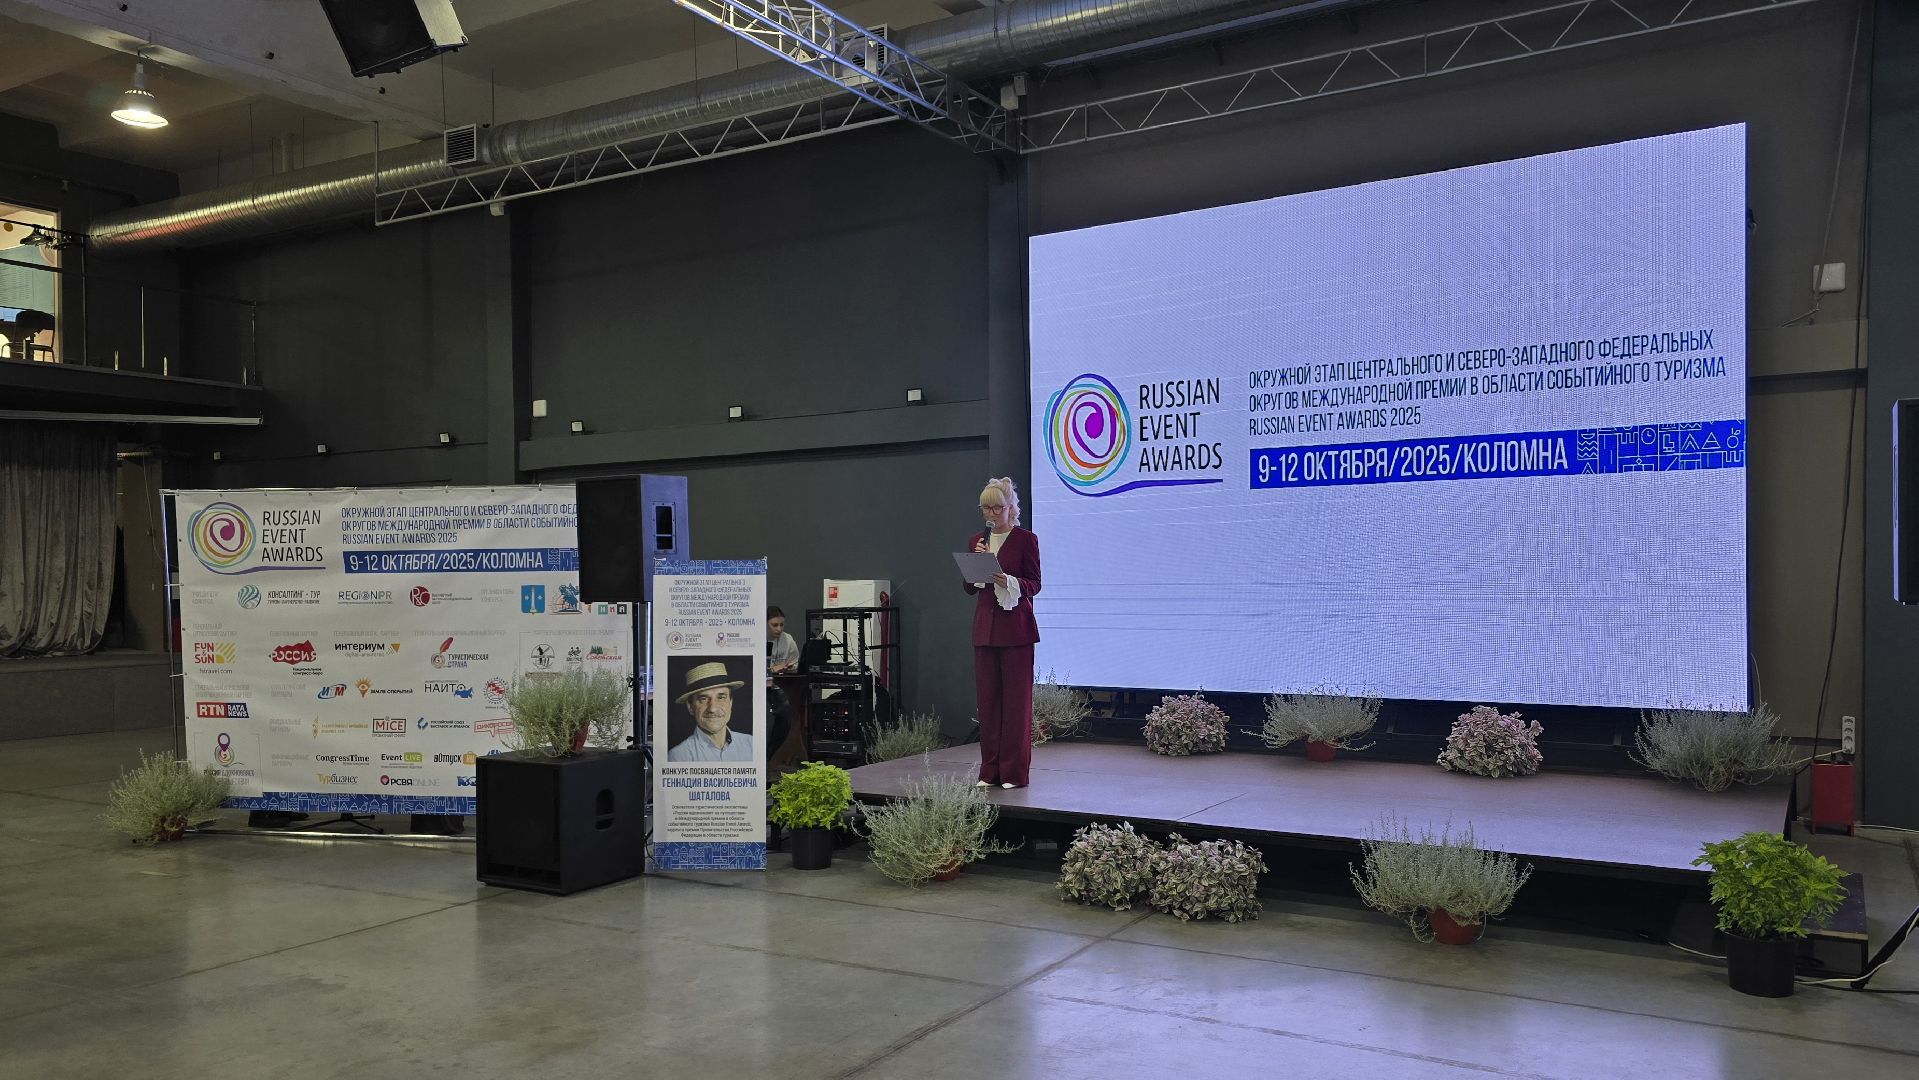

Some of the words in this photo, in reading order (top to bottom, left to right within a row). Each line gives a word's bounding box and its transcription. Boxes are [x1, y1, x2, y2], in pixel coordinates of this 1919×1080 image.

[1249, 363, 1311, 389] ОКРУЖНОЙ
[1314, 363, 1345, 383] ЭТАП
[1347, 353, 1442, 383] ЦЕНТРАЛЬНОГО
[1445, 353, 1455, 372] И
[1457, 340, 1594, 370] СЕВЕРО-ЗАПАДНОГО
[1598, 329, 1714, 360] ФЕДЕРАЛЬНЫХ
[1249, 391, 1299, 412] ОКРУГОВ
[1302, 379, 1413, 409] МЕЖДУНАРОДНОЙ
[1415, 377, 1467, 400] ПРЕМИИ
[1470, 376, 1479, 396] В
[1482, 371, 1544, 395] ОБЛАСТИ
[1547, 362, 1650, 390] СОБЫТИЙНОГО
[1655, 356, 1726, 381] ТУРИЗМА
[1139, 378, 1221, 410] RUSSIAN
[1139, 412, 1200, 442] EVENT
[1249, 415, 1295, 436] RUSSIAN
[1298, 413, 1334, 433] EVENT
[1337, 409, 1387, 431] AWARDS
[1390, 406, 1421, 427] 2025
[1138, 443, 1223, 473] AWARDS
[1258, 453, 1299, 483] 9-12
[1303, 438, 1569, 481] ОКТЯБРЯ/2025/КОЛОМНА
[263, 510, 321, 526] RUSSIAN
[342, 505, 385, 518] ОКРУЖНОЙ
[387, 506, 406, 518] ЭТАП
[408, 505, 469, 518] ЦЕНТРАЛЬНОГО
[471, 505, 477, 516] И
[478, 504, 558, 516] СЕВЕРО-ЗАПАДНОГО
[342, 520, 377, 531] ОКРУГОВ
[378, 517, 451, 532] МЕЖДУНАРОДНОЙ
[452, 518, 485, 530] ПРЕМИИ
[487, 518, 492, 529] В
[493, 517, 529, 529] ОБЛАСТИ
[262, 528, 307, 544] EVENT
[342, 533, 374, 545] RUSSIAN
[375, 533, 400, 544] EVENT
[402, 533, 435, 544] AWARDS
[437, 532, 458, 543] 2025
[261, 547, 323, 562] AWARDS
[350, 554, 378, 571] 9-12
[267, 590, 304, 599] КОНСАЛТИНГ
[310, 590, 320, 599] ТУР
[194, 642, 214, 653] FUN
[334, 643, 385, 652] интериум
[447, 653, 489, 661] ТУРИСТИЧЕСКАЯ
[199, 704, 225, 716] RTN
[315, 754, 370, 763] CongressTime
[381, 753, 402, 761] Event
[662, 778, 701, 788] ГЕННАДИЯ
[703, 778, 757, 788] ВАСИЛЬЕВИЧА
[689, 791, 730, 801] ШАТАЛОВА
